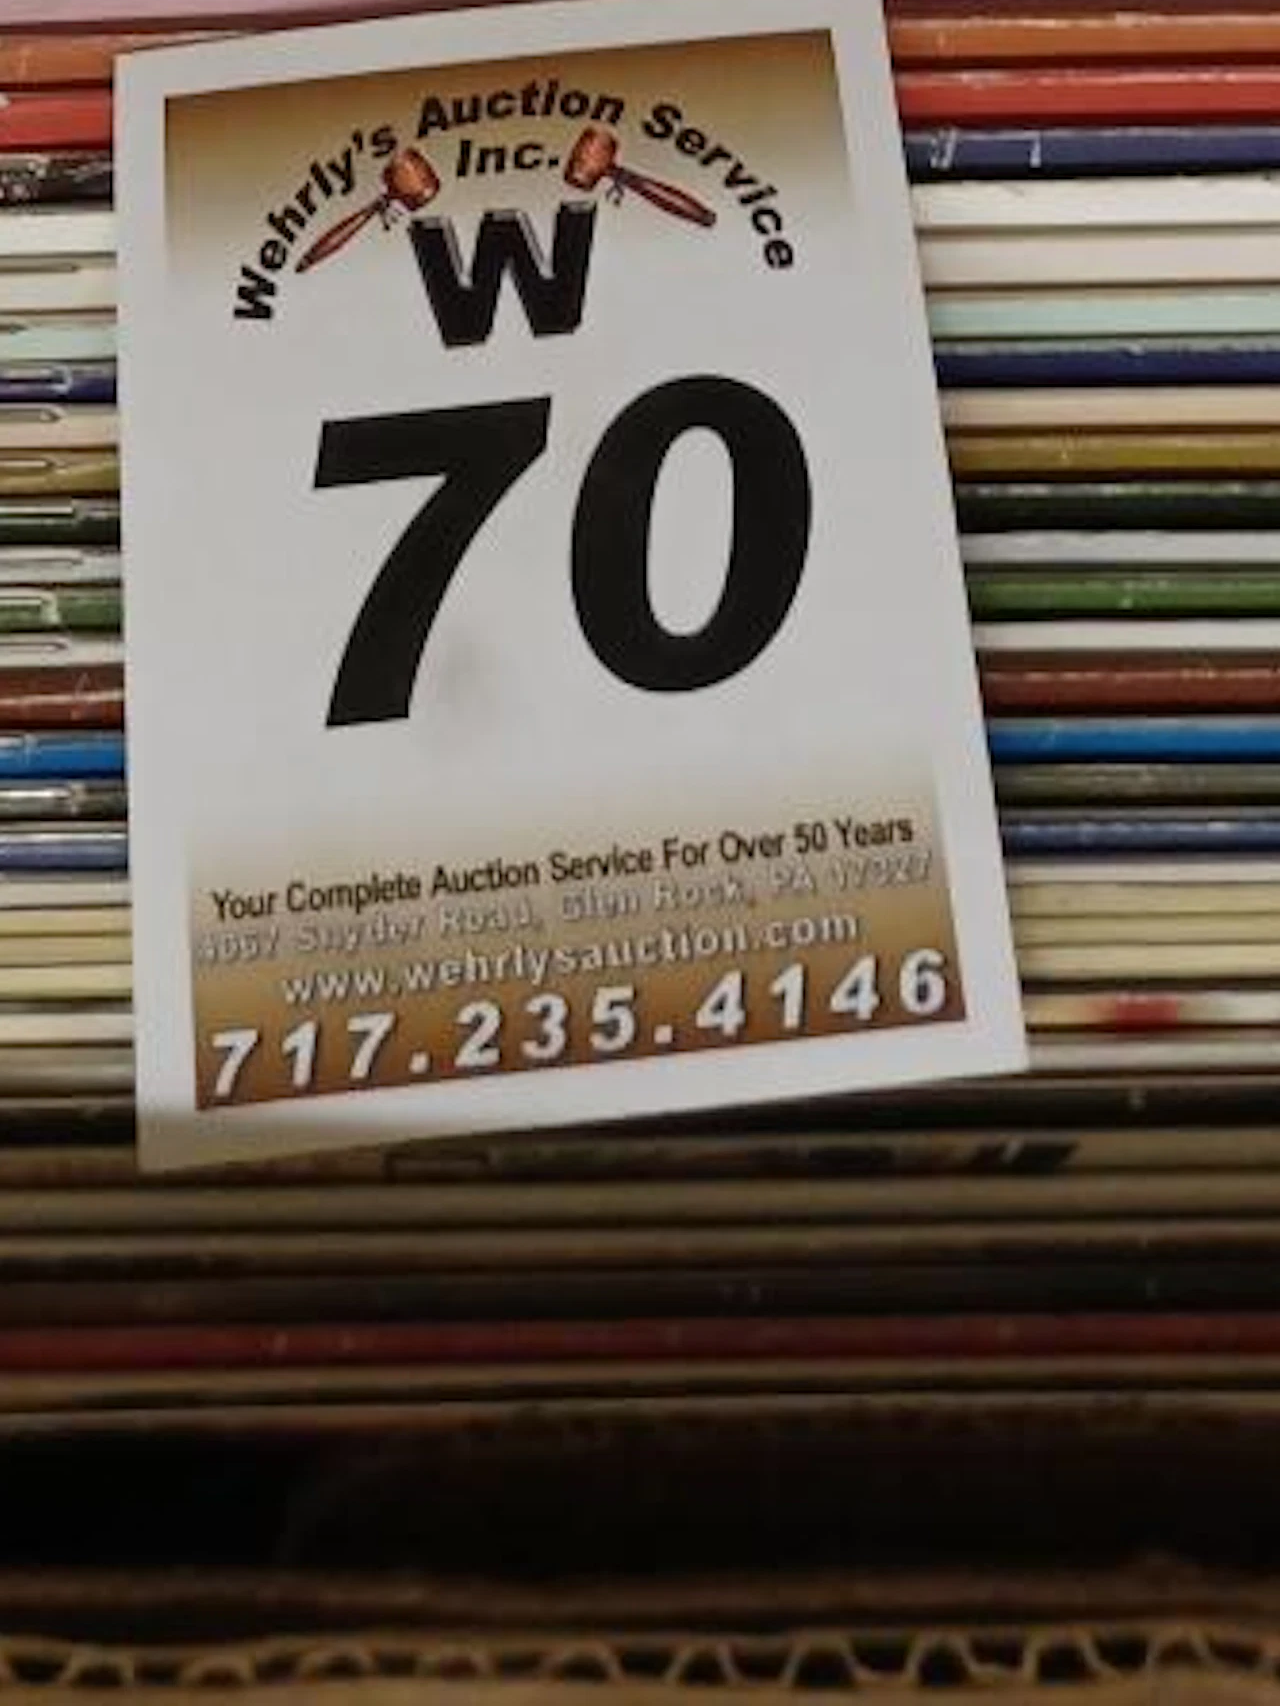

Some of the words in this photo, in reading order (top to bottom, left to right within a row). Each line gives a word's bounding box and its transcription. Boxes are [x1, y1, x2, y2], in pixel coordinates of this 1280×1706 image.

[233, 123, 398, 321] Wehrly's
[415, 78, 626, 140] Auction
[642, 98, 794, 271] Service
[455, 138, 561, 179] Inc.
[407, 199, 598, 351] W
[313, 373, 813, 730] 70
[212, 888, 278, 923] Your
[285, 869, 422, 915] Complete
[431, 856, 541, 897] Auction
[549, 846, 654, 883] Service
[662, 837, 712, 870] For
[719, 828, 787, 865] Over
[793, 821, 829, 856] 50
[832, 815, 915, 847] Years
[211, 947, 948, 1098] 717.235.4146
[282, 911, 859, 1006] www.wehrlysauction.com
